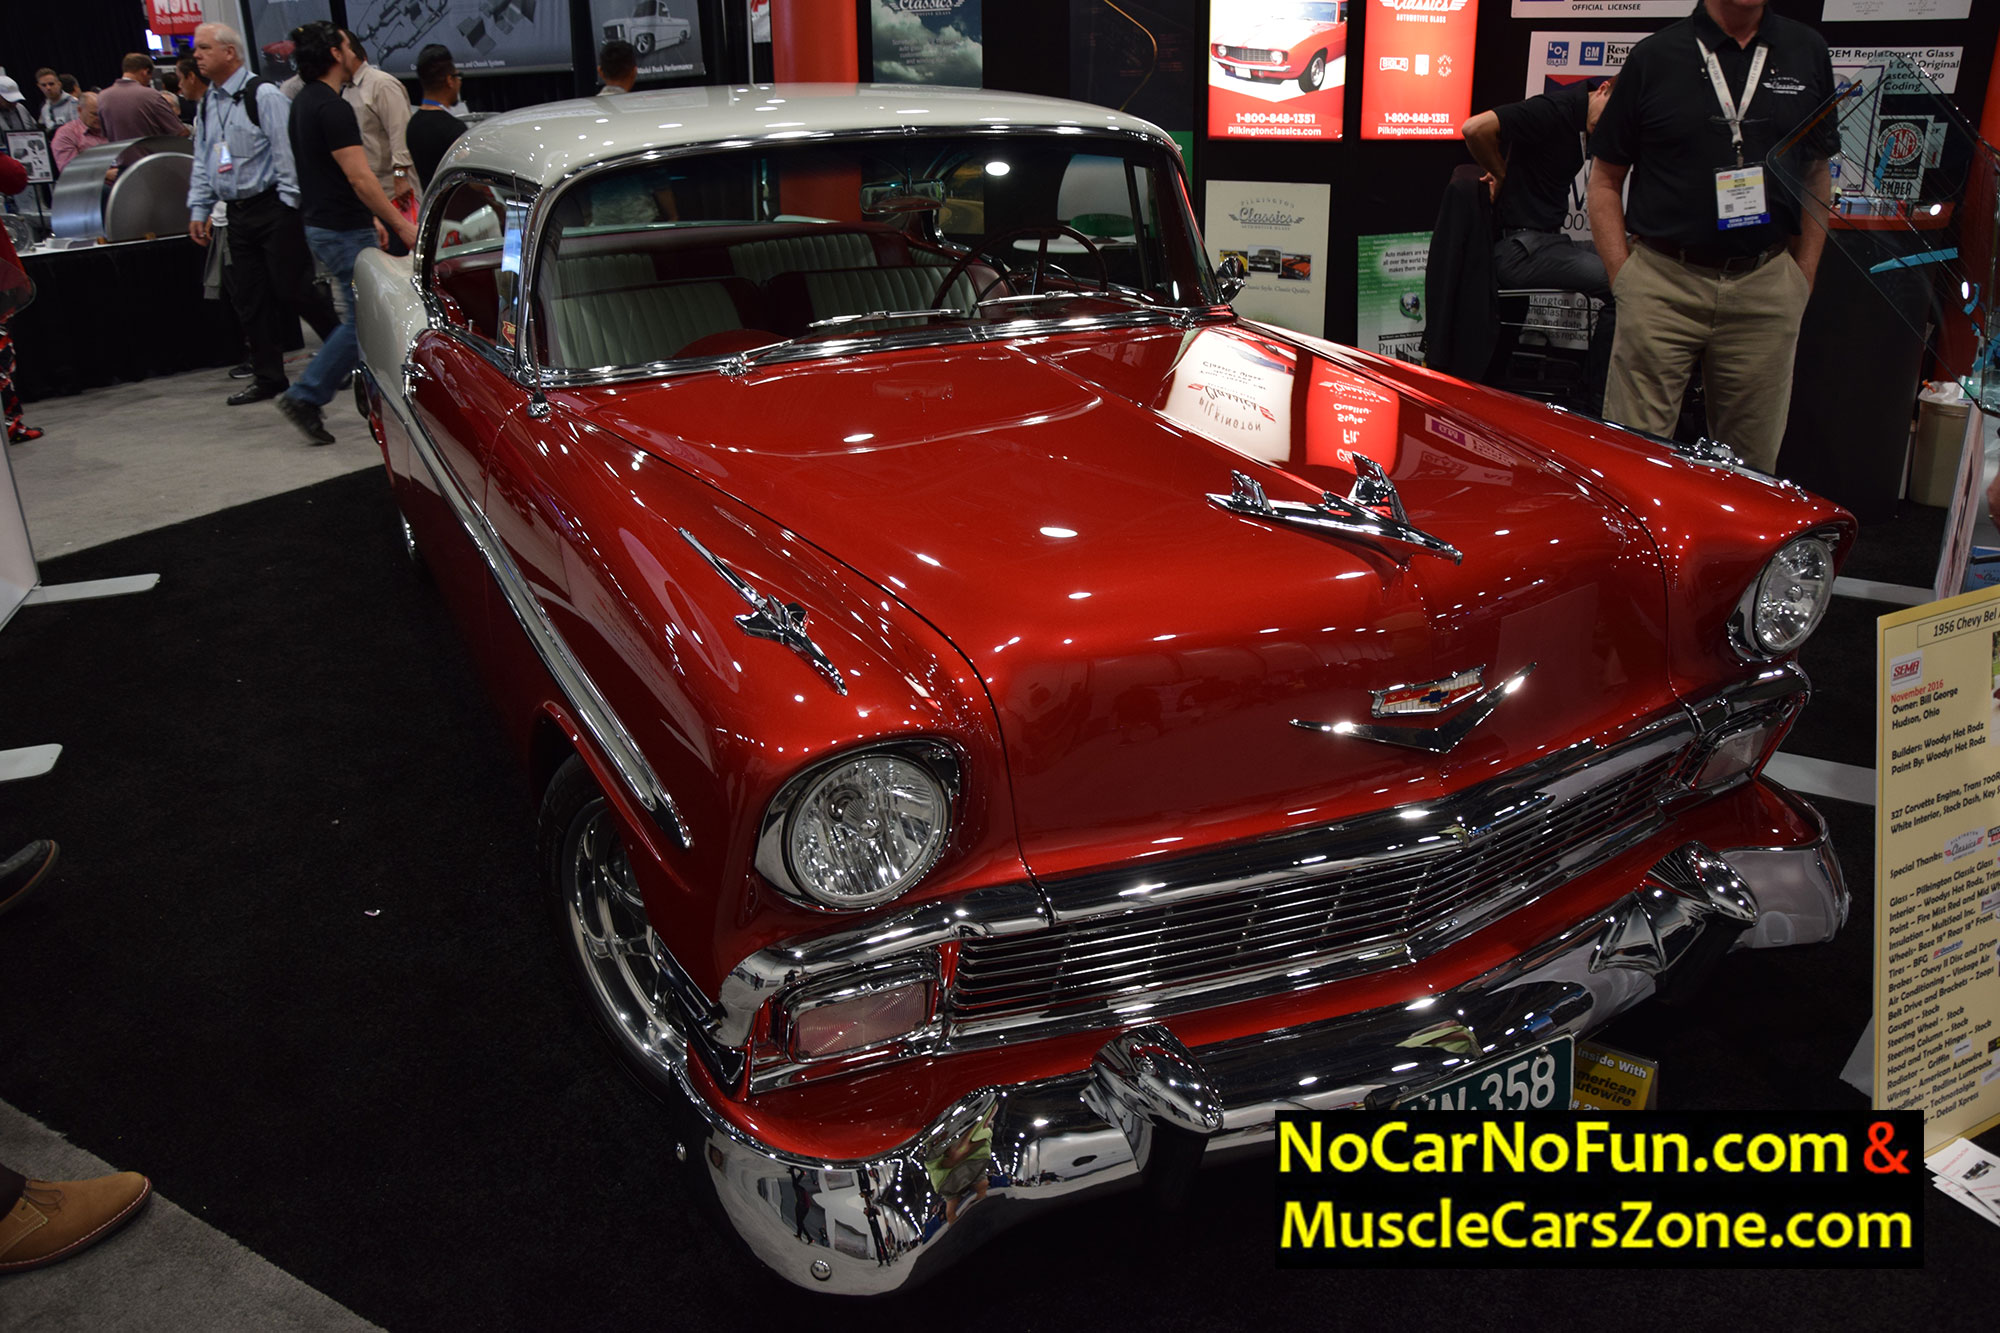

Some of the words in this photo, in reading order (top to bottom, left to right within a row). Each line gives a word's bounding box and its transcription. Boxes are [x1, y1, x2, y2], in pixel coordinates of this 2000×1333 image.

[1607, 3, 1641, 11] LICENSEE
[1585, 46, 1600, 58] GM
[1917, 60, 1960, 70] Original
[1926, 49, 1955, 58] Glass
[1883, 82, 1922, 93] Coding
[1917, 72, 1945, 82] Logo
[1236, 113, 1316, 124] 1-800-848-1351
[1378, 125, 1454, 136] Pilkingtonclassics.com
[1384, 112, 1450, 123] 1-800-848-1351
[1228, 125, 1321, 137] Pilkingtonclassics.com
[1240, 207, 1294, 224] Classics
[1933, 620, 1955, 637] 1956
[1956, 614, 1982, 630] Chevy
[1984, 607, 1997, 623] Bel
[1893, 660, 1920, 678] SEMA
[1891, 685, 1926, 704] November
[1927, 679, 1944, 693] 2016
[1892, 700, 1918, 714] Owner:
[1920, 694, 1931, 706] Bill
[1933, 687, 1958, 702] George
[1892, 714, 1922, 730] Hudson,
[1923, 707, 1940, 719] Ohio
[1892, 743, 1923, 760] Builders:
[1924, 733, 1951, 749] Woodys
[1953, 727, 1966, 739] Hot
[1967, 721, 1984, 735] Rodz
[1891, 761, 1912, 775] Paint
[1913, 757, 1925, 768] By:
[1926, 747, 1954, 762] Woodys
[1955, 741, 1968, 753] Hot
[1969, 735, 1986, 748] Rodz
[1890, 820, 1912, 834] White
[1913, 809, 1942, 827] Interior,
[1962, 793, 1982, 808] Dash,
[1983, 788, 1996, 800] Key
[1891, 808, 1903, 820] 327
[1904, 797, 1935, 815] Corvette
[1936, 788, 1962, 804] Engine,
[1963, 779, 1982, 793] Trans
[1890, 861, 1915, 879] Special
[1916, 852, 1943, 868] Thanks:
[1889, 893, 1908, 907] Glass
[1916, 876, 1952, 897] Pilkington
[1953, 865, 1975, 880] Classic
[1976, 858, 1994, 871] Glass
[1889, 905, 1916, 922] Interior
[1924, 889, 1951, 907] Woodys
[1952, 884, 1965, 896] Hot
[1889, 921, 1909, 936] Paint
[1917, 913, 1930, 925] Fire
[1932, 906, 1946, 918] Mist
[1947, 899, 1961, 910] Red
[1962, 892, 1976, 905] and
[1977, 886, 1990, 899] Mid
[1947, 926, 1964, 940] Rear
[1975, 912, 1994, 927] Front
[1889, 930, 1924, 951] Insulation
[1888, 976, 1913, 993] Brakes
[1920, 963, 1942, 978] Chevy
[1949, 953, 1963, 965] Disc
[1964, 945, 1978, 958] and
[1979, 938, 1998, 951] Drum
[1888, 966, 1905, 979] Tires
[1913, 953, 1928, 968] BFG
[1888, 996, 1900, 1007] Air
[1900, 976, 1945, 1001] Conditioning
[1952, 960, 1979, 977] Vintage
[1980, 954, 1990, 964] Air
[1888, 1008, 1903, 1021] Belt
[1904, 1000, 1923, 1014] Drive
[1924, 990, 1938, 1004] and
[1939, 978, 1968, 997] Brackets
[1887, 1030, 1916, 1049] Steering
[1917, 1016, 1939, 1034] Wheel
[1888, 1018, 1914, 1034] Gauges
[1887, 1043, 1916, 1063] Steering
[1917, 1030, 1943, 1048] Column
[1887, 1060, 1907, 1077] Hood
[1908, 1052, 1922, 1066] and
[1944, 1032, 1967, 1048] Hinges
[1618, 1060, 1648, 1079] With
[1887, 1069, 1918, 1090] Radiator
[1928, 1053, 1950, 1070] Griffin
[1887, 1087, 1911, 1103] Wiring
[1918, 1067, 1951, 1088] American
[1952, 1050, 1983, 1070] Autowire
[1575, 1081, 1633, 1107] utowire
[1576, 1071, 1637, 1098] merican
[1936, 1101, 1957, 1118] Detail
